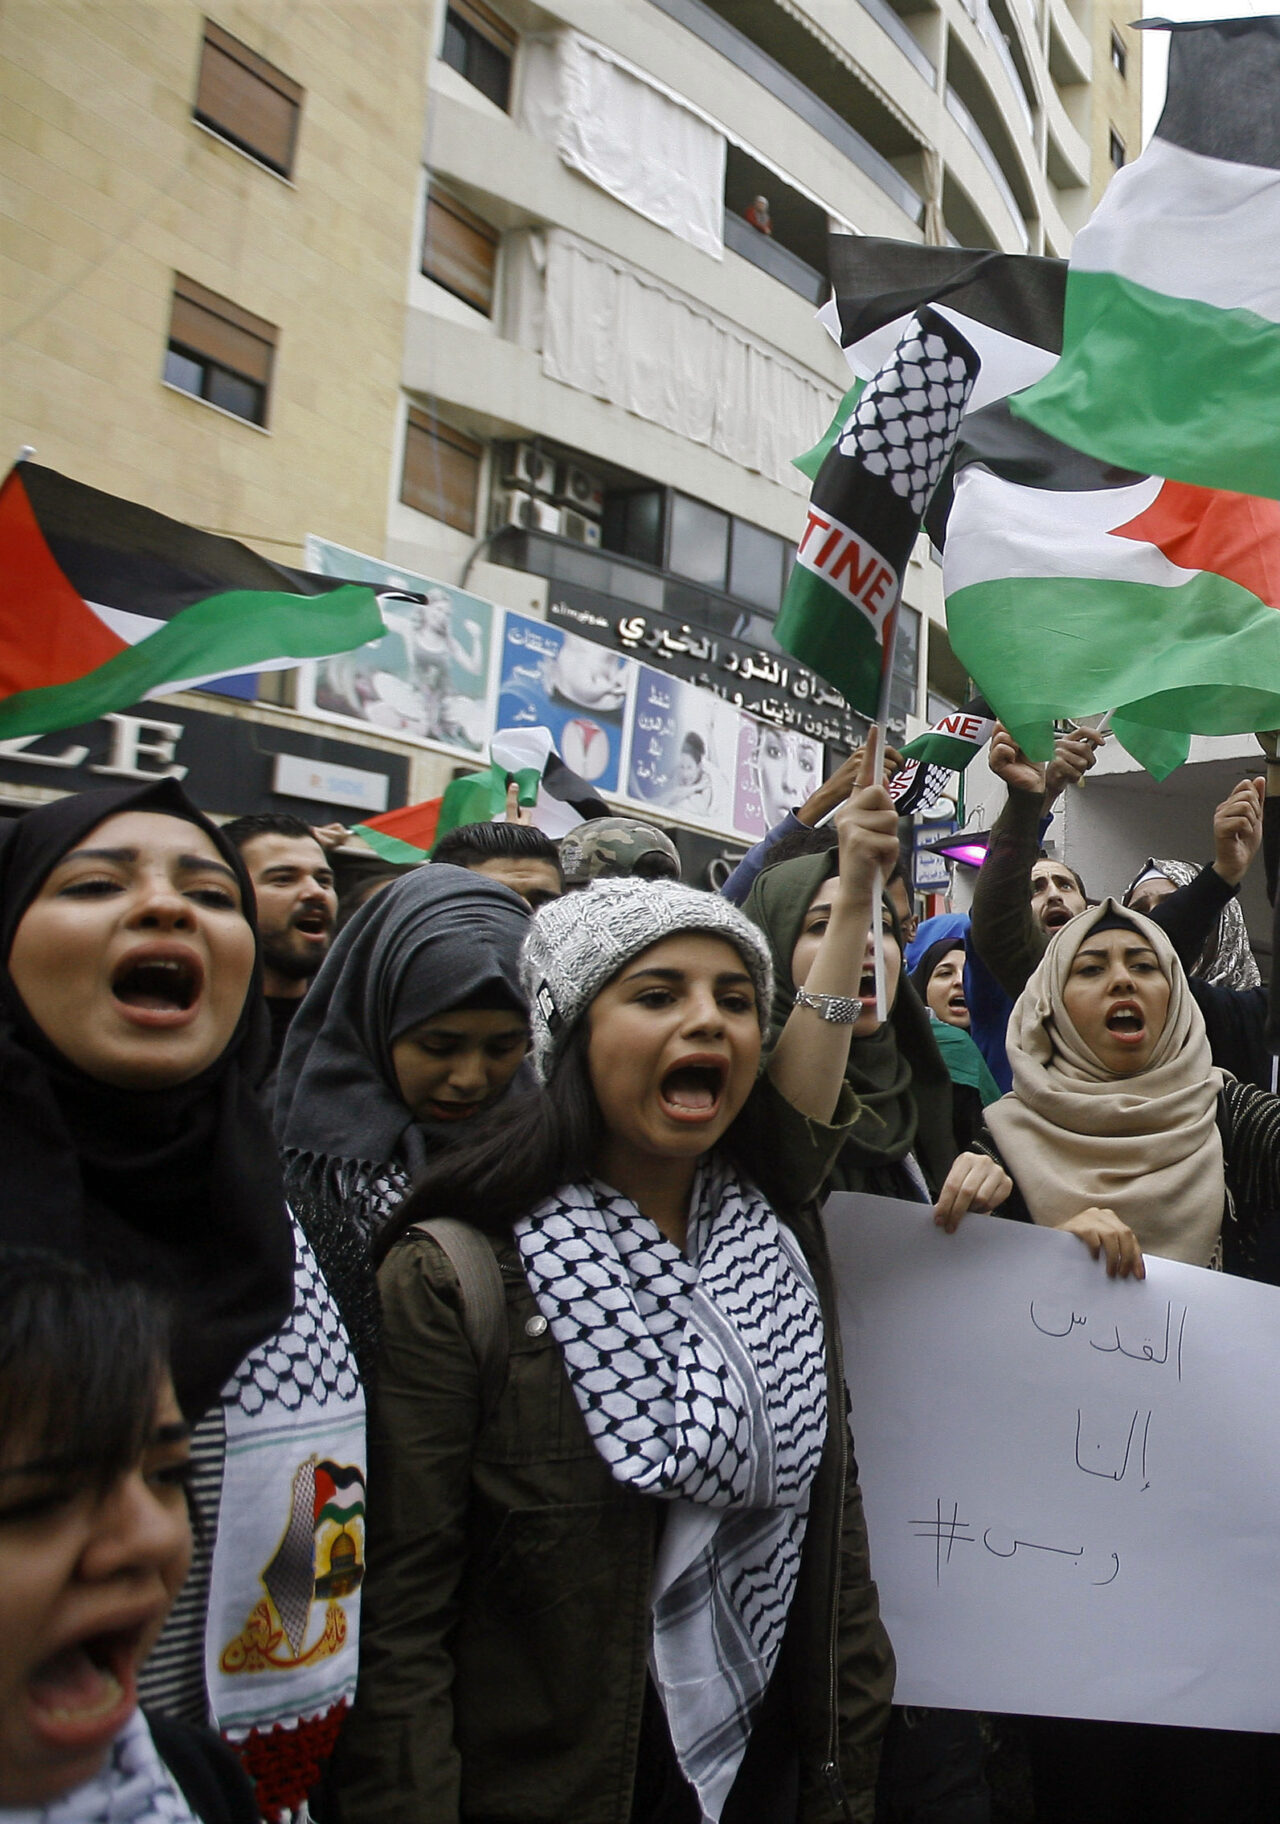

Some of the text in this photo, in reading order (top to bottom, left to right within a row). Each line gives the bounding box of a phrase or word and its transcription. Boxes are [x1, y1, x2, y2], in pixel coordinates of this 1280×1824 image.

[930, 715, 984, 740] NE
[1029, 1300, 1188, 1383] القدس
[221, 1600, 348, 1674] فلسطين
